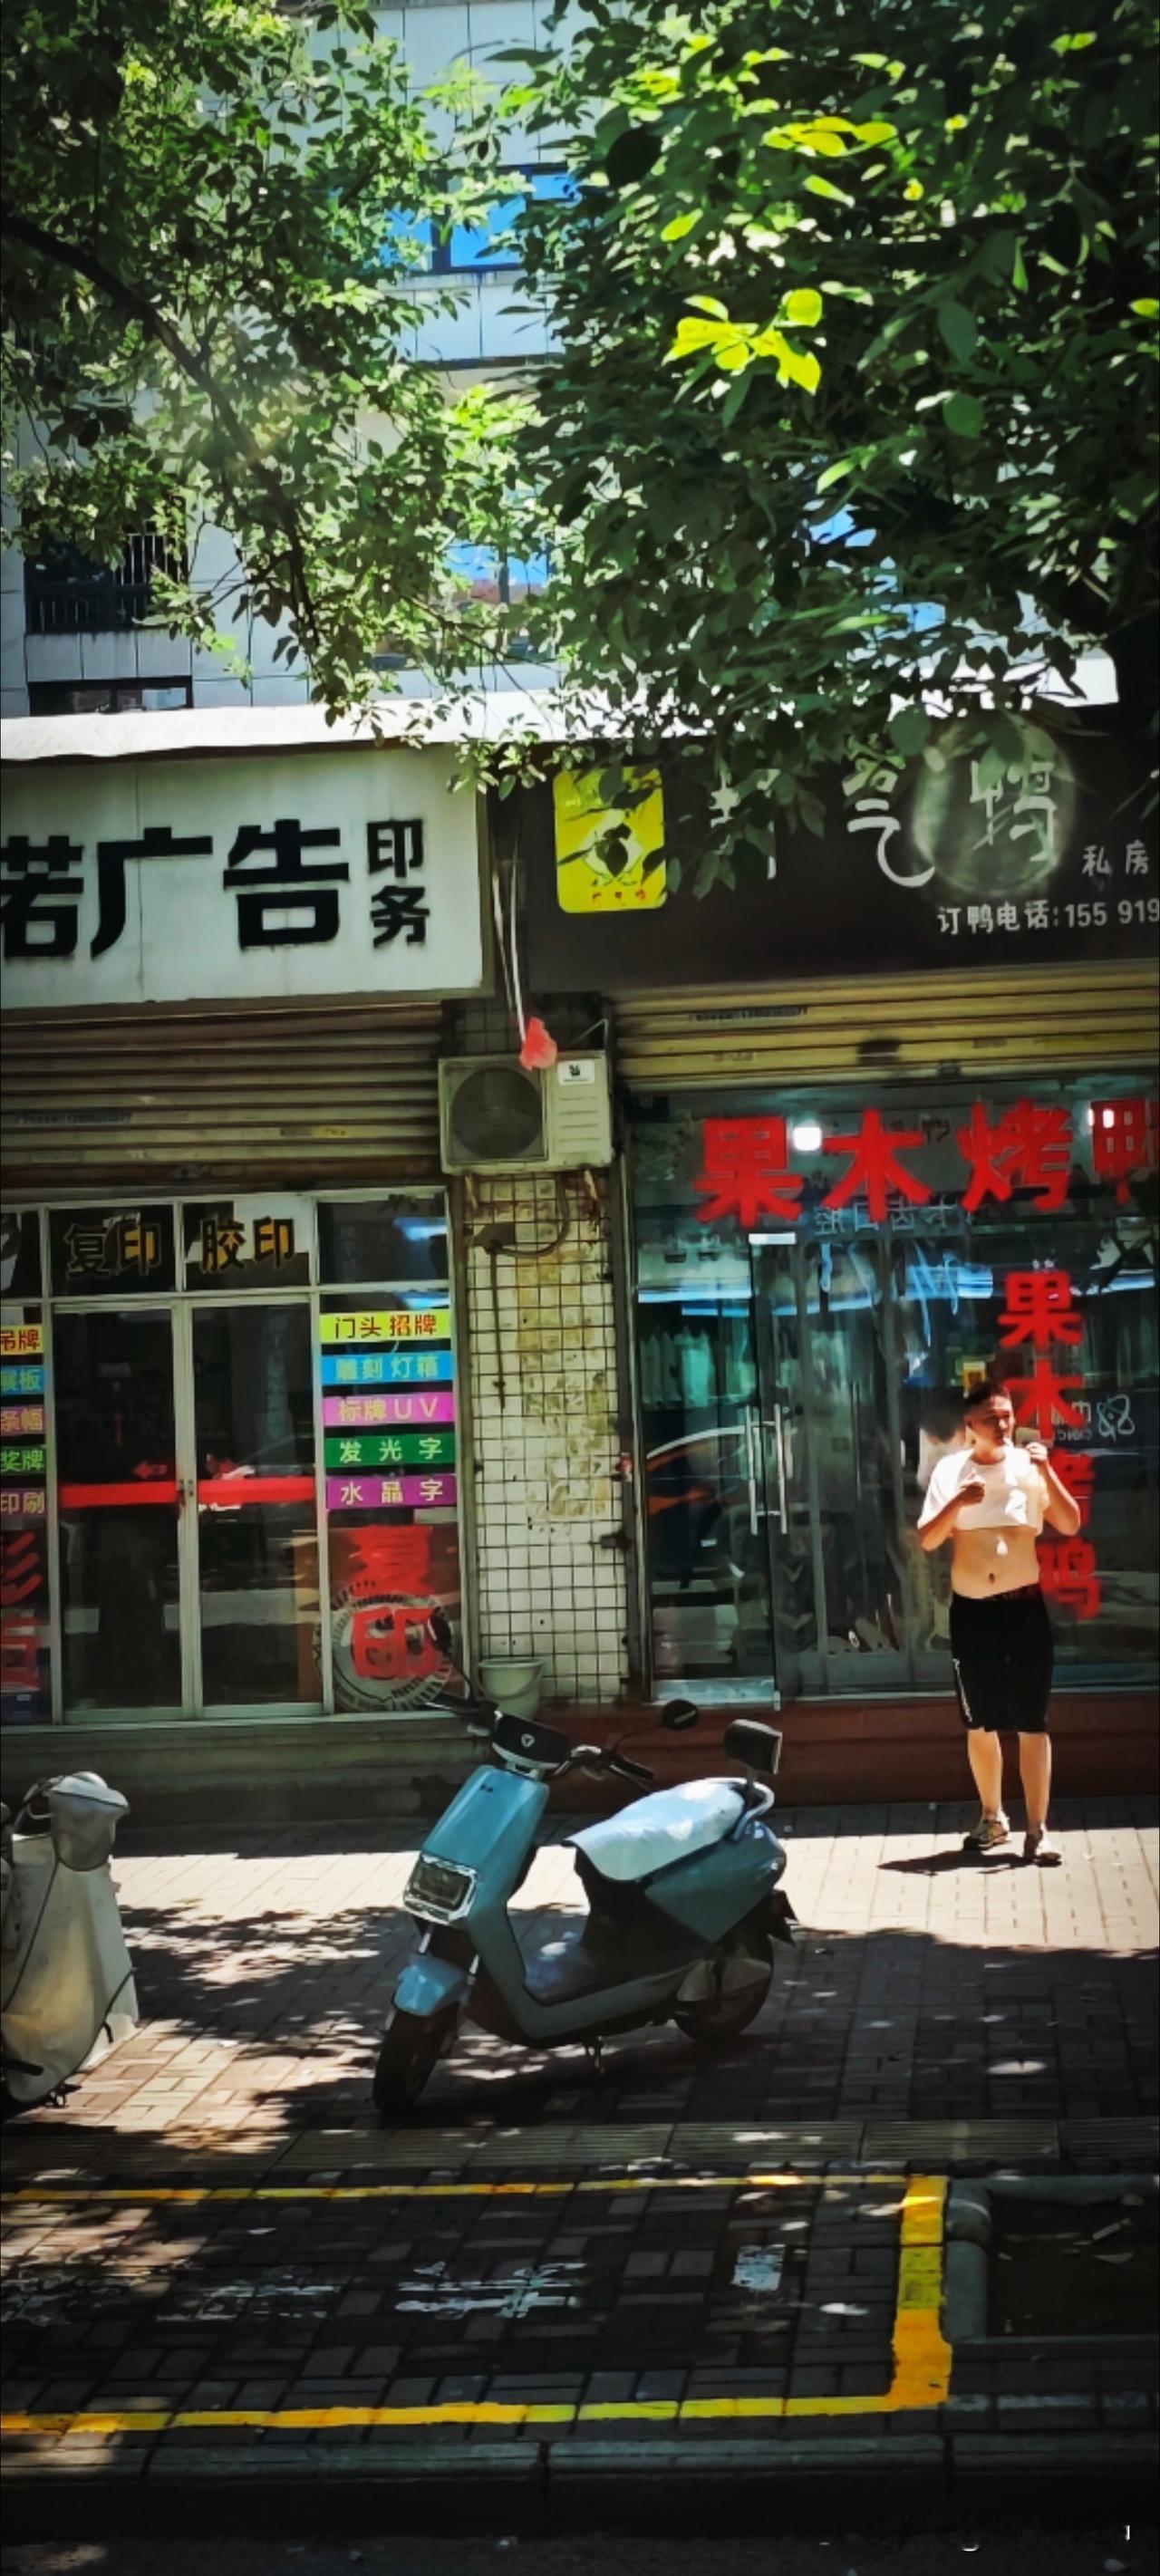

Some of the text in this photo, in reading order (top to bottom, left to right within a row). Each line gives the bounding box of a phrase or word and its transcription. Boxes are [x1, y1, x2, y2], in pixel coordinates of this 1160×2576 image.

[1082, 841, 1149, 876] 私房
[366, 818, 430, 950] 印务
[63, 1214, 295, 1280] 复印 胶印
[334, 1313, 437, 1339] 门头招牌
[334, 1355, 440, 1382] 雕刻灯箱
[0, 1407, 44, 1432] 条幅
[0, 1449, 44, 1472] 奖牌
[339, 1437, 443, 1464] 发光字
[0, 1491, 45, 1515] 印刷
[340, 1479, 444, 1506] 水晶字
